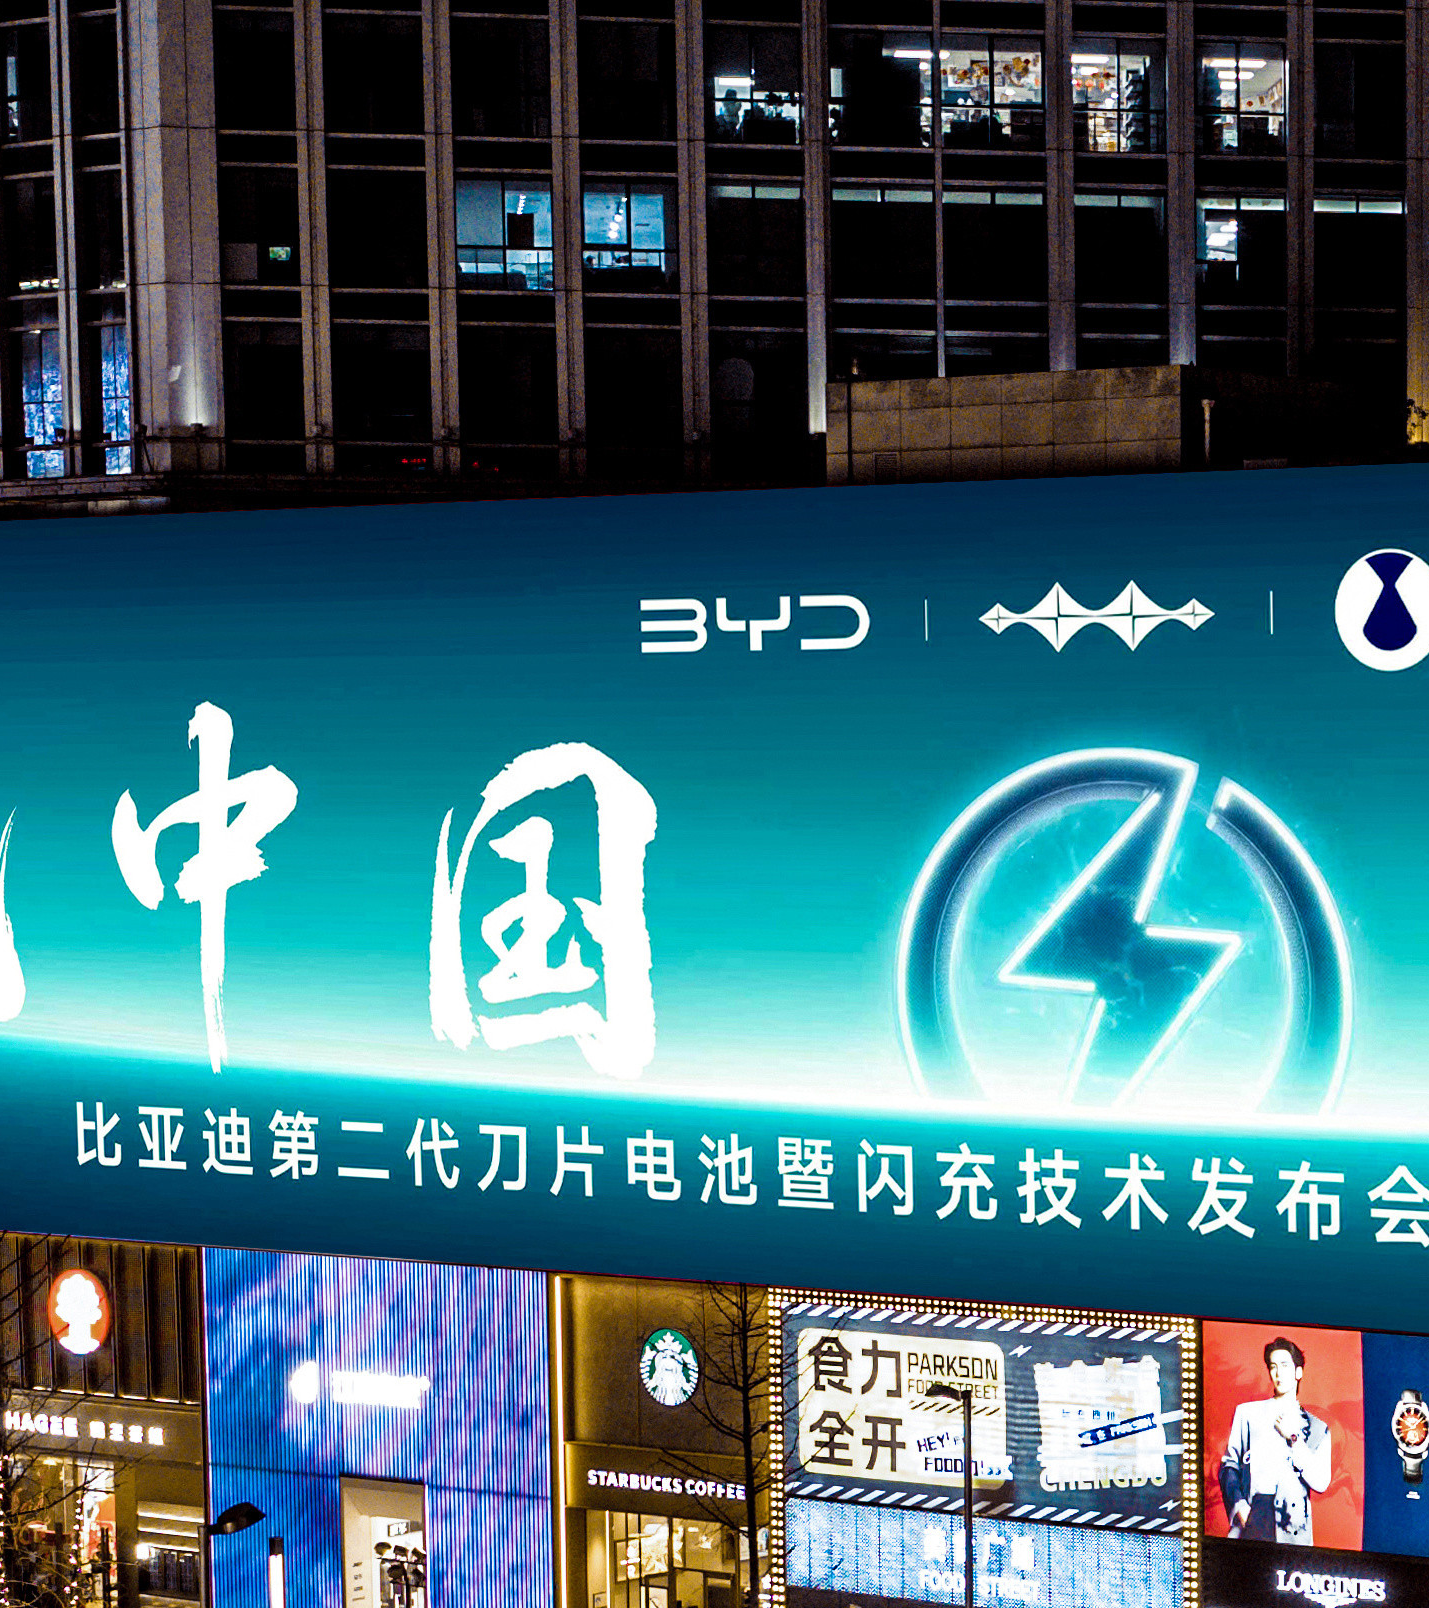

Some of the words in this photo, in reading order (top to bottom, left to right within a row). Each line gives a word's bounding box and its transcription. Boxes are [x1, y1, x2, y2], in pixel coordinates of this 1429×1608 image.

[641, 596, 869, 652] BYD
[809, 1335, 902, 1399] 食力
[907, 1352, 998, 1381] PARKSON
[809, 1410, 906, 1473] 全开
[587, 1469, 683, 1495] STARBUCKS
[684, 1479, 746, 1500] COFFEE
[919, 1568, 965, 1593] FOOD
[1276, 1569, 1386, 1602] LONGINES
